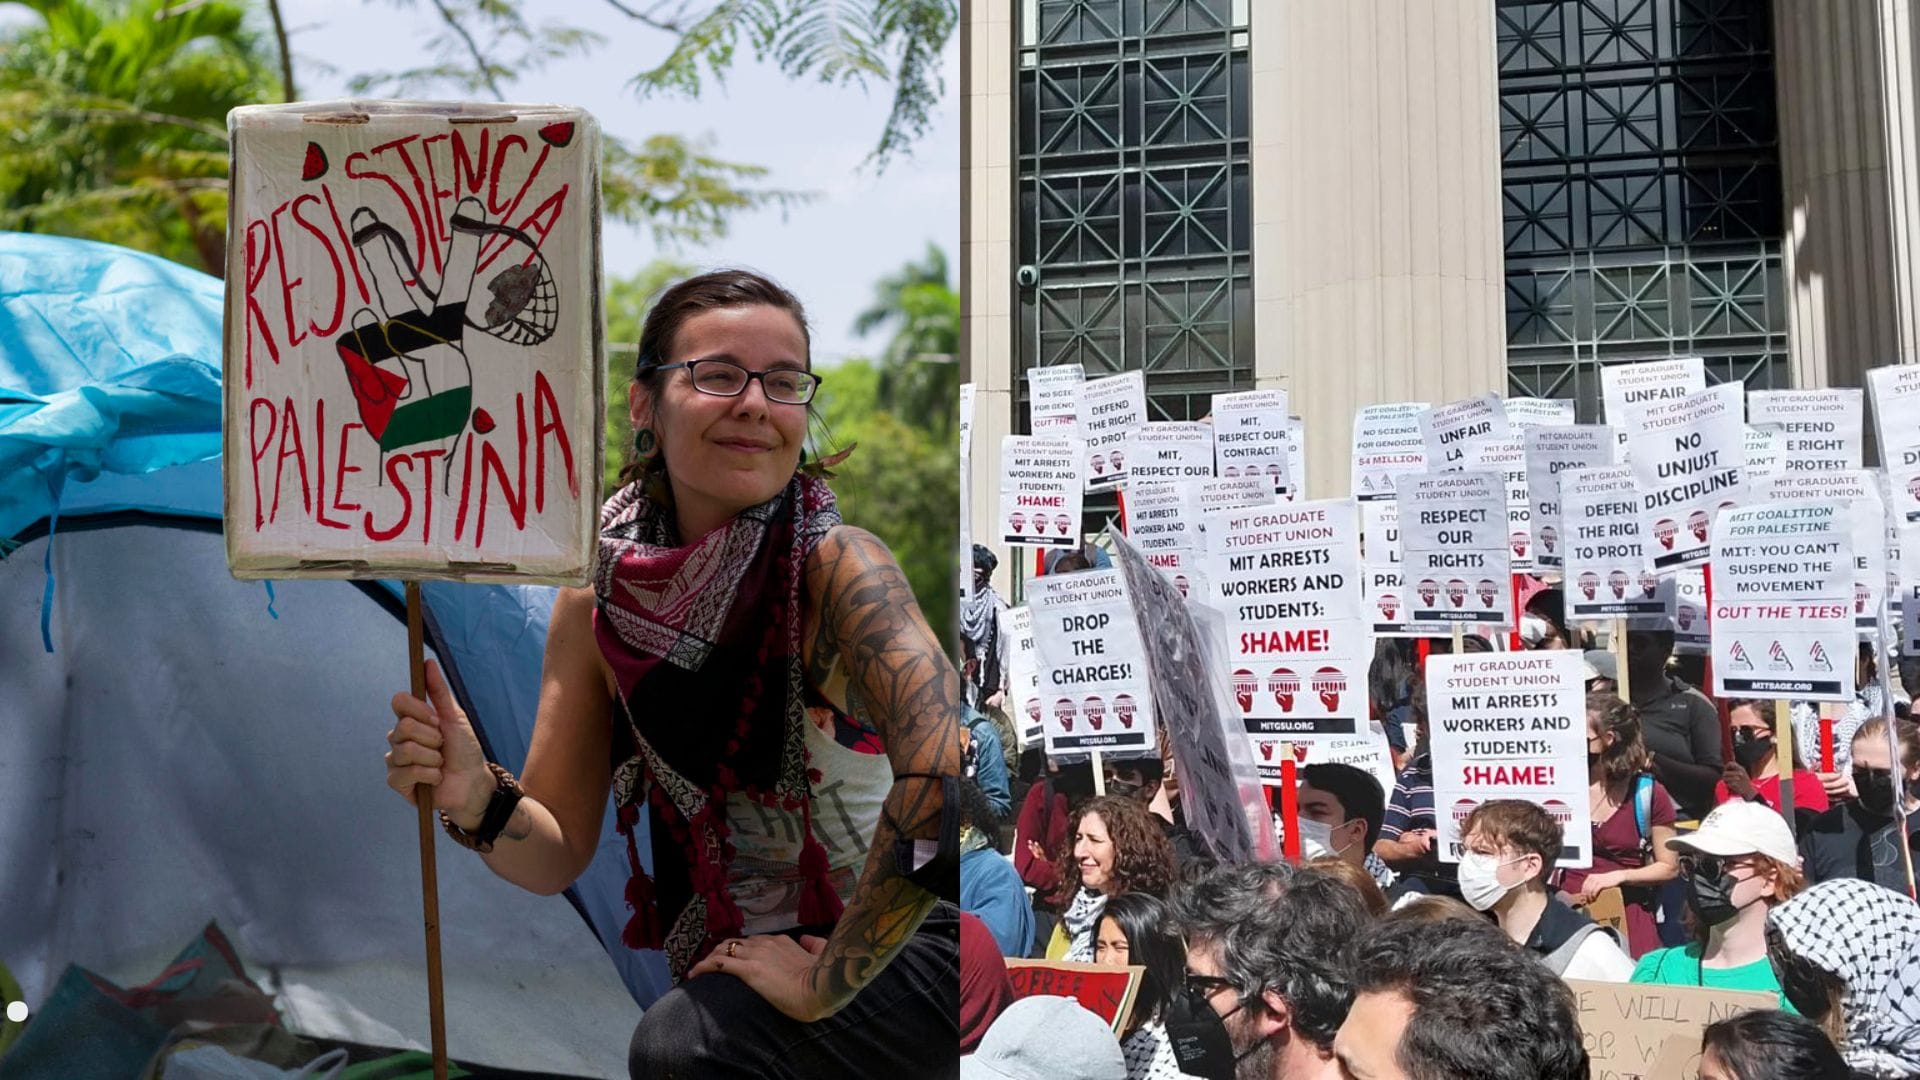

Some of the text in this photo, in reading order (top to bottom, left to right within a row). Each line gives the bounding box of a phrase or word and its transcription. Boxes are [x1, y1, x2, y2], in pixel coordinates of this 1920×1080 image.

[1638, 364, 1684, 374] GRADUATE
[1617, 373, 1690, 386] STUDENT UNION
[1898, 371, 1919, 381] MIT
[1624, 386, 1686, 403] UNFAIR
[1789, 395, 1840, 403] GRADUATE
[1091, 400, 1129, 416] DEFEND
[1447, 400, 1486, 416] GRADUATE
[1647, 392, 1720, 418] MIT GRADUATE
[1766, 405, 1810, 413] STUDENT
[1034, 418, 1053, 428] CUT
[1088, 413, 1137, 432] THE RIGHT
[1240, 417, 1261, 426] MIT,
[1431, 408, 1492, 429] STUDENT UNION
[1642, 403, 1725, 430] STUDENT UNION
[1219, 430, 1286, 442] RESPECT OUR
[1378, 426, 1418, 435] SCIENCE
[1439, 421, 1492, 444] UNFAIR
[1553, 432, 1593, 440] GRADUATE
[1086, 437, 1099, 448] TO
[1375, 439, 1423, 447] GENOCIDE
[1536, 443, 1569, 451] STUDENT
[1675, 432, 1702, 452] NO
[1799, 440, 1845, 451] RIGHT
[1158, 451, 1182, 460] MIT,
[1223, 446, 1279, 458] CONTRACT!
[1480, 454, 1523, 462] STUDENT
[250, 370, 578, 548] PALESTINA
[1033, 459, 1070, 467] ARRESTS
[1372, 455, 1422, 464] MILLION
[1657, 450, 1719, 478] UNJUST
[1786, 460, 1848, 471] PROTEST
[1009, 471, 1075, 480] WORKERS AND
[1131, 466, 1210, 476] RESPECT OUR
[1579, 472, 1596, 482] MIT
[1219, 482, 1260, 490] GRADUATE
[1437, 478, 1484, 487] GRADUATE
[1576, 484, 1617, 493] STUDENT
[1775, 477, 1858, 487] MIT GRADUATE
[1415, 489, 1490, 500] STUDENT UNION
[1645, 469, 1739, 510] DISCIPLINE
[1769, 488, 1864, 500] STUDENT UNION
[1017, 495, 1065, 507] SHAME!
[1200, 492, 1265, 503] STUDENT UNION
[1136, 508, 1178, 520] MIT ARRESTS
[1230, 510, 1325, 530] MIT GRADUATE
[1421, 509, 1487, 524] RESPECT
[1729, 507, 1834, 522] MIT COALITION
[1133, 522, 1185, 535] WORKERS AND
[1578, 526, 1605, 539] THE
[1730, 522, 1831, 536] FOR PALESTINE
[1225, 527, 1333, 548] STUDENT UNION
[1438, 530, 1473, 544] OUR
[1574, 547, 1596, 560] TO
[1721, 542, 1840, 557] MIT: YOU CAN'T
[1230, 549, 1330, 571] MIT ARRESTS
[1428, 554, 1484, 568] RIGHTS
[1729, 561, 1832, 575] SUSPEND THE
[1047, 575, 1117, 592] MIT GRADUATE
[1221, 574, 1344, 597] WORKERS AND
[1736, 580, 1825, 593] MOVEMENT
[1044, 588, 1122, 605] STUDENT UNION
[1239, 601, 1324, 621] STUDENTS:
[1717, 606, 1848, 619] CUT THE TIES!
[1062, 613, 1109, 633] DROP
[1072, 638, 1104, 656] THE
[1240, 629, 1330, 654] SHAME!
[1453, 659, 1553, 673] MIT GRADUATE
[1052, 663, 1132, 685] CHARGES!
[1447, 674, 1561, 688] STUDENT UNION
[1451, 693, 1558, 710] MIT ARRESTS
[1261, 721, 1314, 730] MITGSU.ORG
[1443, 716, 1571, 732] WORKERS AND
[1464, 740, 1552, 755] STUDENTS:
[1463, 766, 1555, 786] SHAME!
[1614, 993, 1689, 1023] WILL
